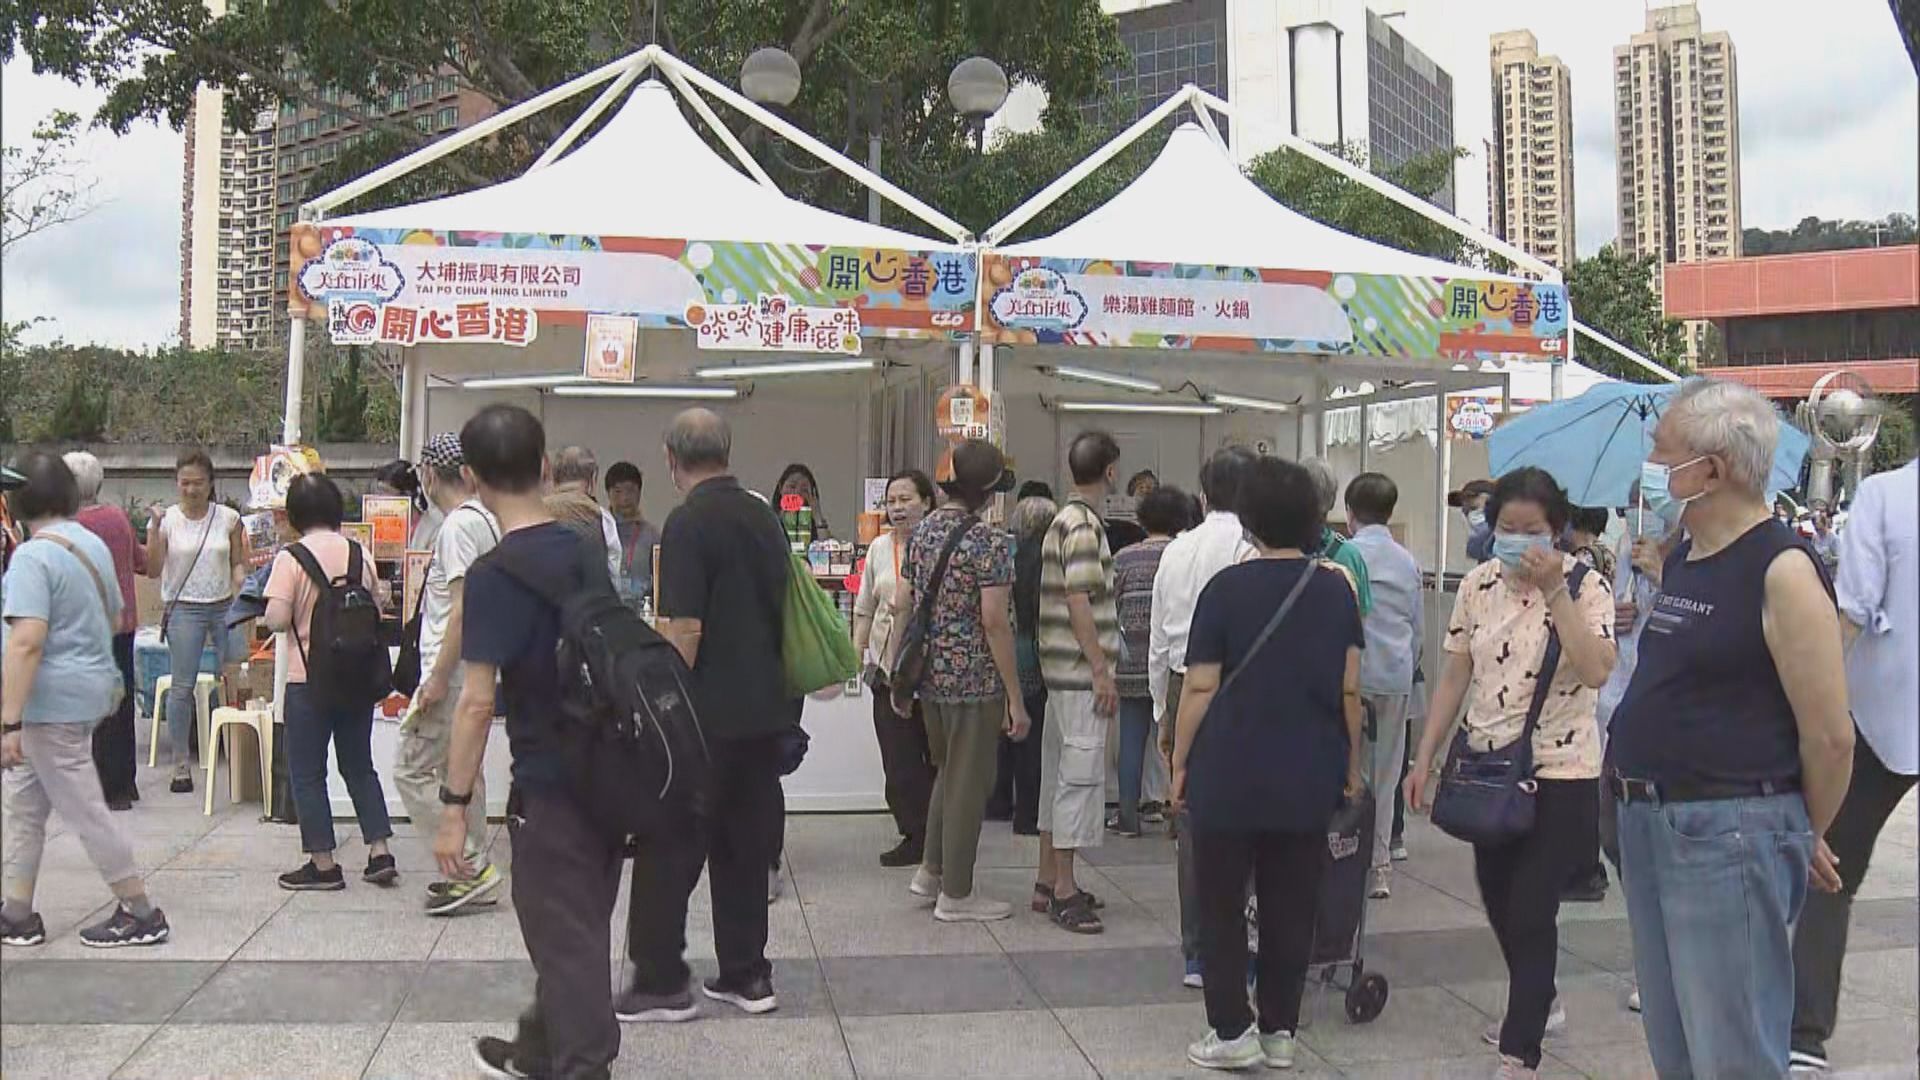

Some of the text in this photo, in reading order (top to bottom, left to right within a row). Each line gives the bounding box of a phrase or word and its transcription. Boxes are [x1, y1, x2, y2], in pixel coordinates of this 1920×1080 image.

[314, 271, 388, 291] 美食市集
[416, 260, 581, 286] 大埔振興有限公司
[827, 250, 967, 298] 開心香港
[416, 285, 568, 299] TAI PO CHUN HING LIMITED
[1451, 283, 1561, 325] 開心香港
[1005, 298, 1073, 318] 美食市集
[380, 302, 528, 344] 開心香港
